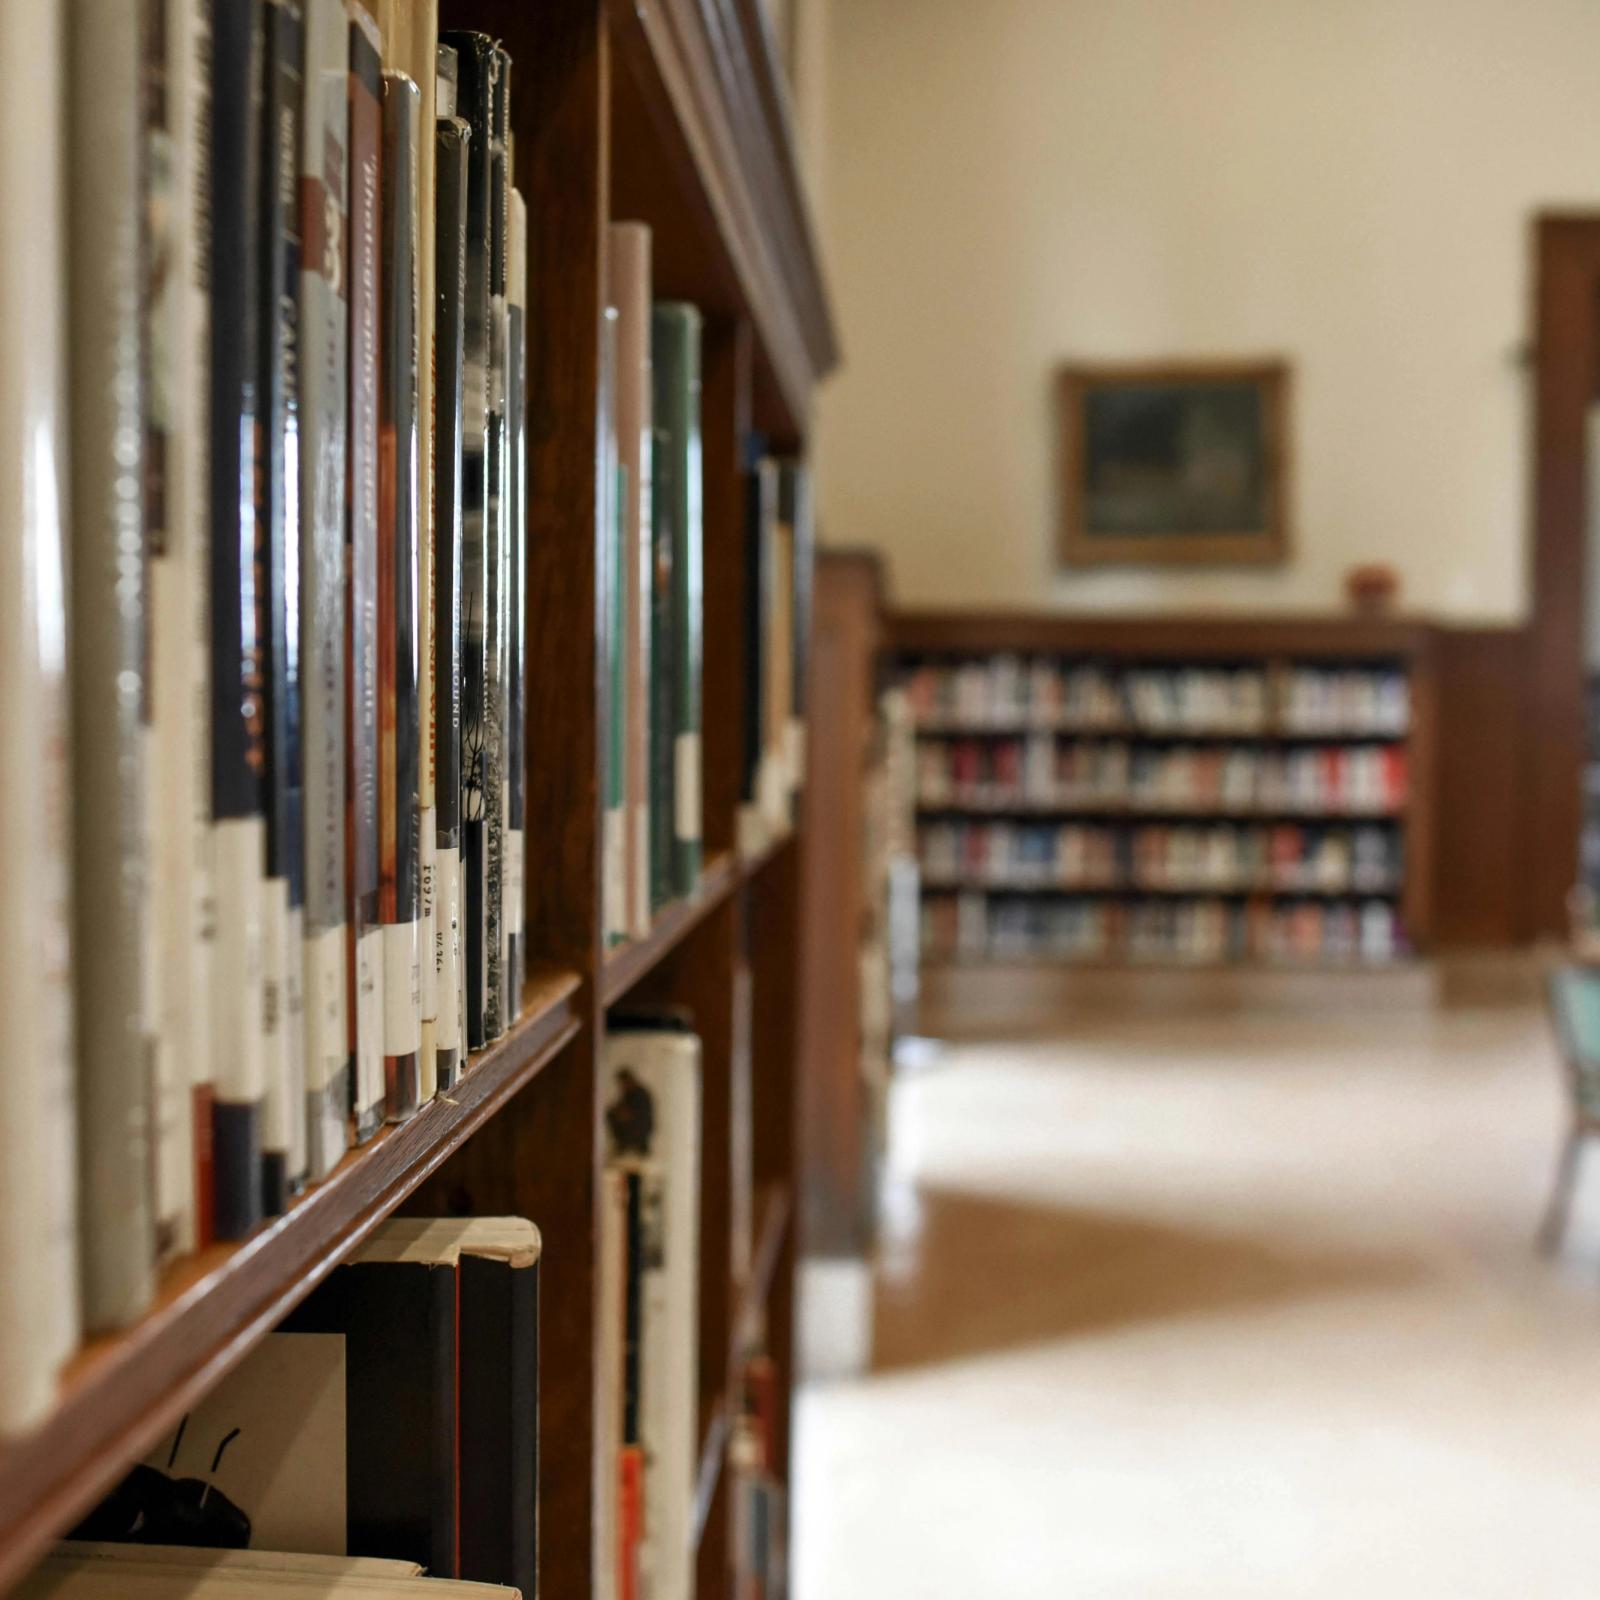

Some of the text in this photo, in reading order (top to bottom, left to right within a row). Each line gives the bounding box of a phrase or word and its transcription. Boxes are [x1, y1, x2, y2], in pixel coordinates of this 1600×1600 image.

[362, 161, 375, 392] photography
[363, 644, 374, 727] wells
[452, 649, 460, 729] AROUND
